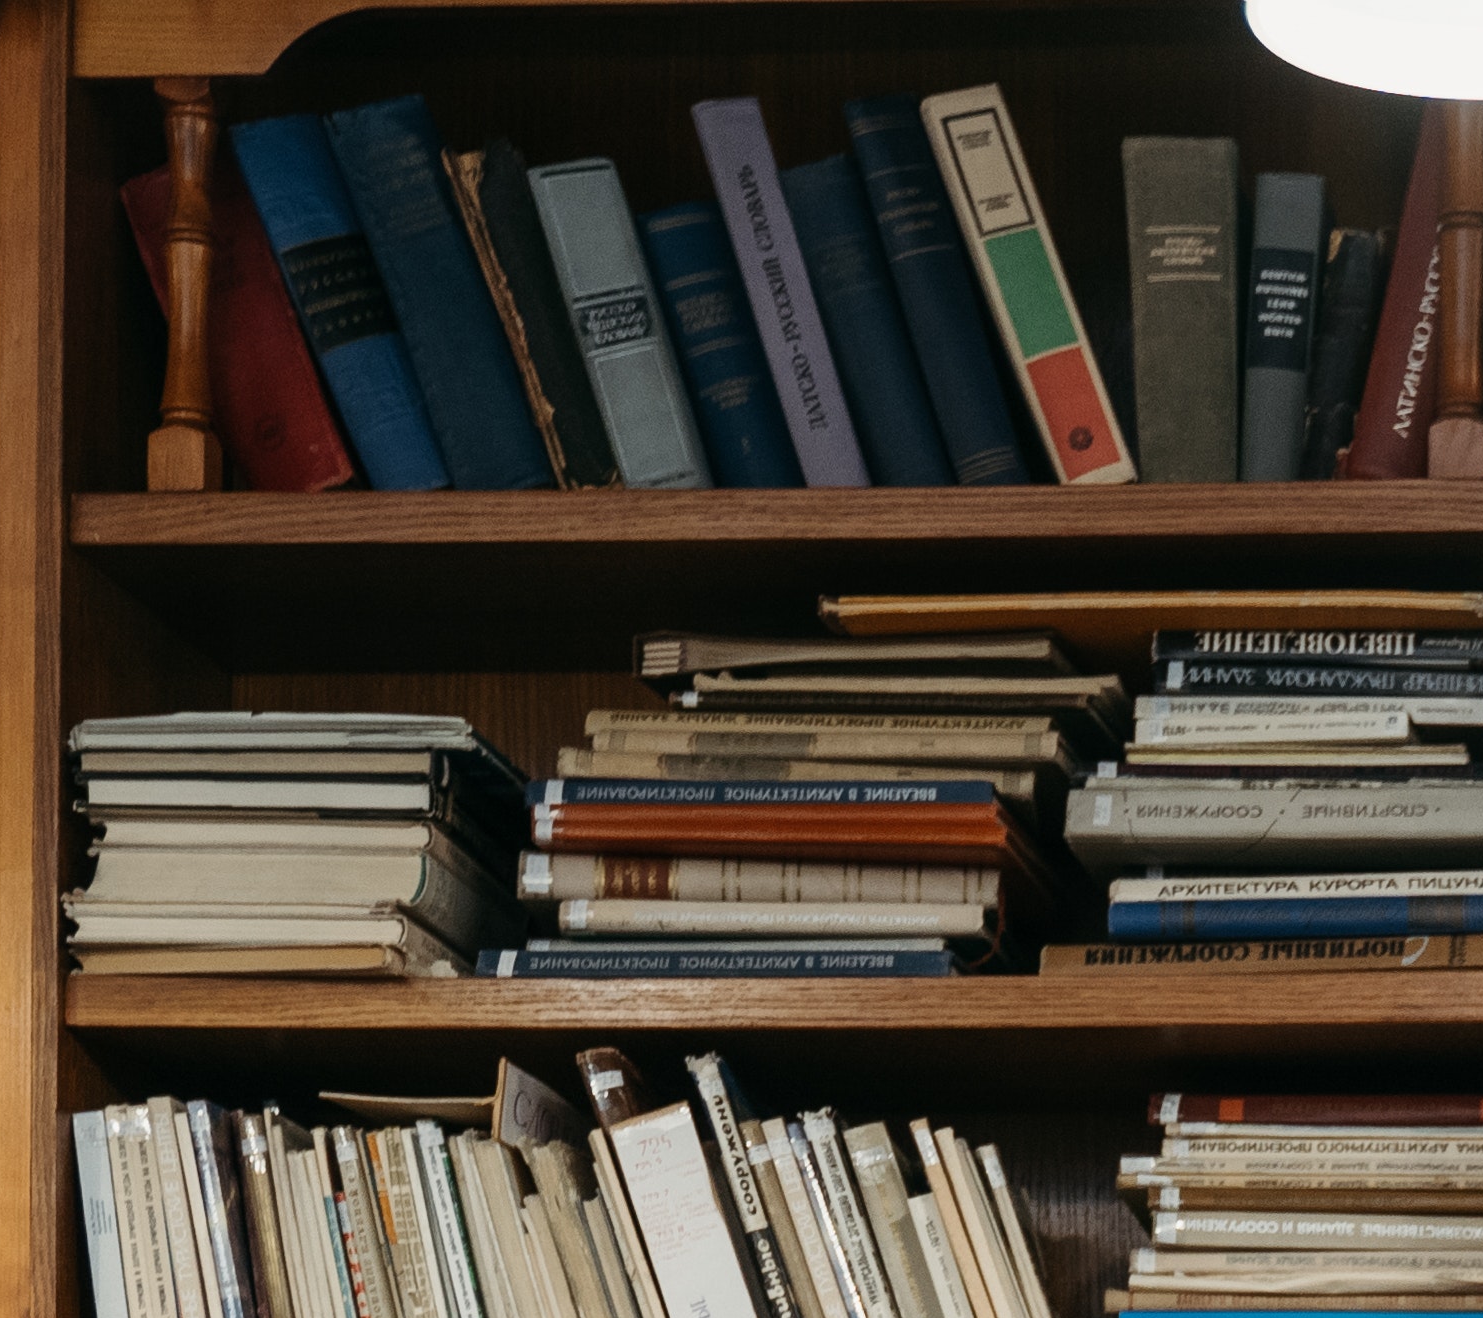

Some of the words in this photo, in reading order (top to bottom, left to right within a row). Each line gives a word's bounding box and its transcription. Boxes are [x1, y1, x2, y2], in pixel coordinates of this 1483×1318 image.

[733, 162, 778, 253] СЛОВАРЬ
[760, 255, 828, 432] ДАТСКО-РУССКИЙ
[1194, 631, 1415, 655] ЦВЕТОВЕДЕНИЕ
[608, 709, 669, 725] ЗДАНИЙ
[675, 710, 736, 726] ЖИЛЫХ
[742, 711, 884, 728] ПРОЕКТИРОВАНИЕ
[891, 716, 1025, 732] АРХИТЕКТУРНОЕ
[576, 784, 714, 800] ПРОЕКТИРОВАНИЕ
[723, 785, 843, 800] АРХИТЕКТУРНОЕ
[848, 786, 857, 800] В
[864, 786, 936, 801] ВВЕДЕНИЕ
[1135, 803, 1262, 819] СООРУЖЕНИЯ
[1300, 803, 1428, 819] СПОРТИВНЫЕ
[1157, 882, 1299, 899] АРХИТЕКТУРА
[1308, 879, 1398, 894] КУРОРТА
[678, 955, 799, 970] АРХИТЕКТУРНОЕ
[804, 955, 813, 969] В
[820, 954, 894, 969] ВВЕДЕНИЕ
[1084, 943, 1249, 966] СООРУЖЕНИЯ
[529, 955, 669, 971] ПРОЕКТИРОВАНИЕ
[1187, 1141, 1311, 1153] ПРОЕКТИРОВАНИ
[1317, 1142, 1448, 1154] АРХИТЕКТУРНОГО
[712, 1094, 758, 1218] сооружени
[1184, 1219, 1278, 1234] СООРУЖЕНИ
[1281, 1221, 1292, 1234] И
[1297, 1221, 1355, 1236] ЗДАНИЯ
